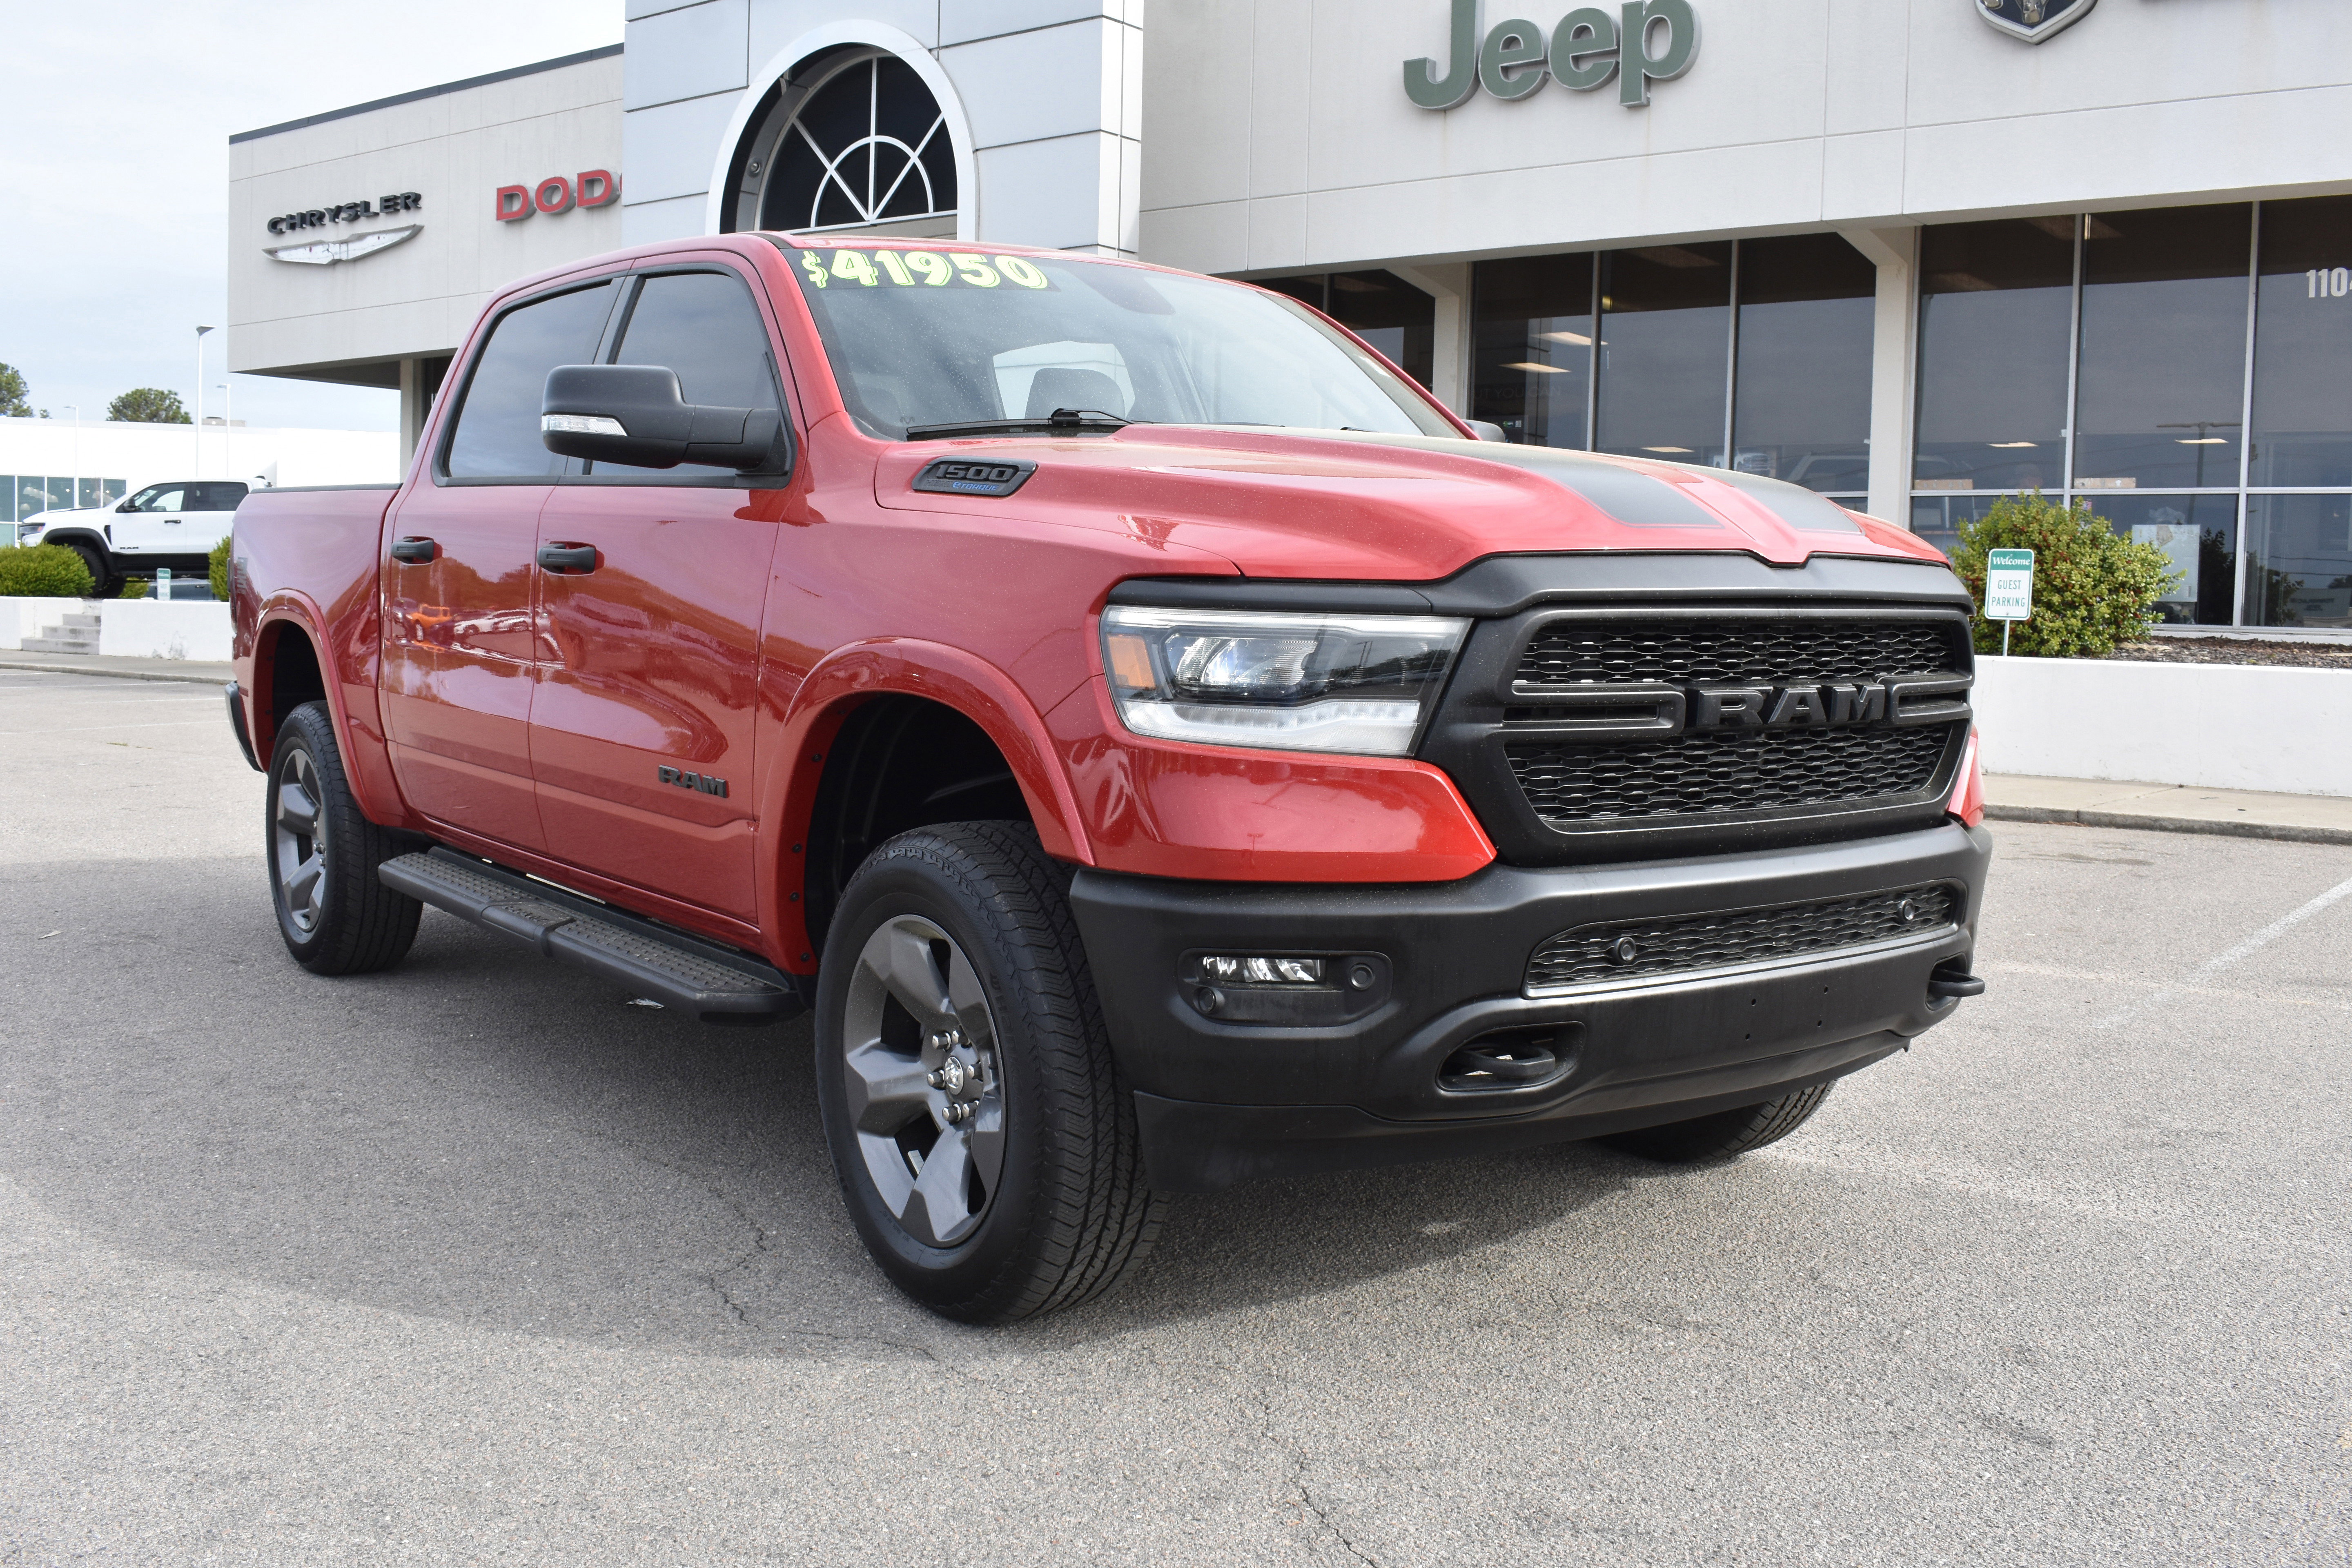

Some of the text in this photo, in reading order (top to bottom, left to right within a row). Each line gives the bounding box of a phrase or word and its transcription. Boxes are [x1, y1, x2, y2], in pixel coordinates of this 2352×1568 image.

[1403, 0, 1701, 110] Jeep
[267, 191, 422, 234] CHRYSLER
[496, 169, 622, 222] DOD
[802, 249, 1048, 288] $41950
[2306, 267, 2352, 298] 110
[934, 464, 1015, 482] 1500
[1993, 556, 2031, 566] Welcome
[1991, 597, 2025, 607] PARKING
[1998, 580, 2021, 590] GUEST
[1697, 684, 1886, 725] RAM
[658, 764, 728, 799] RAM
